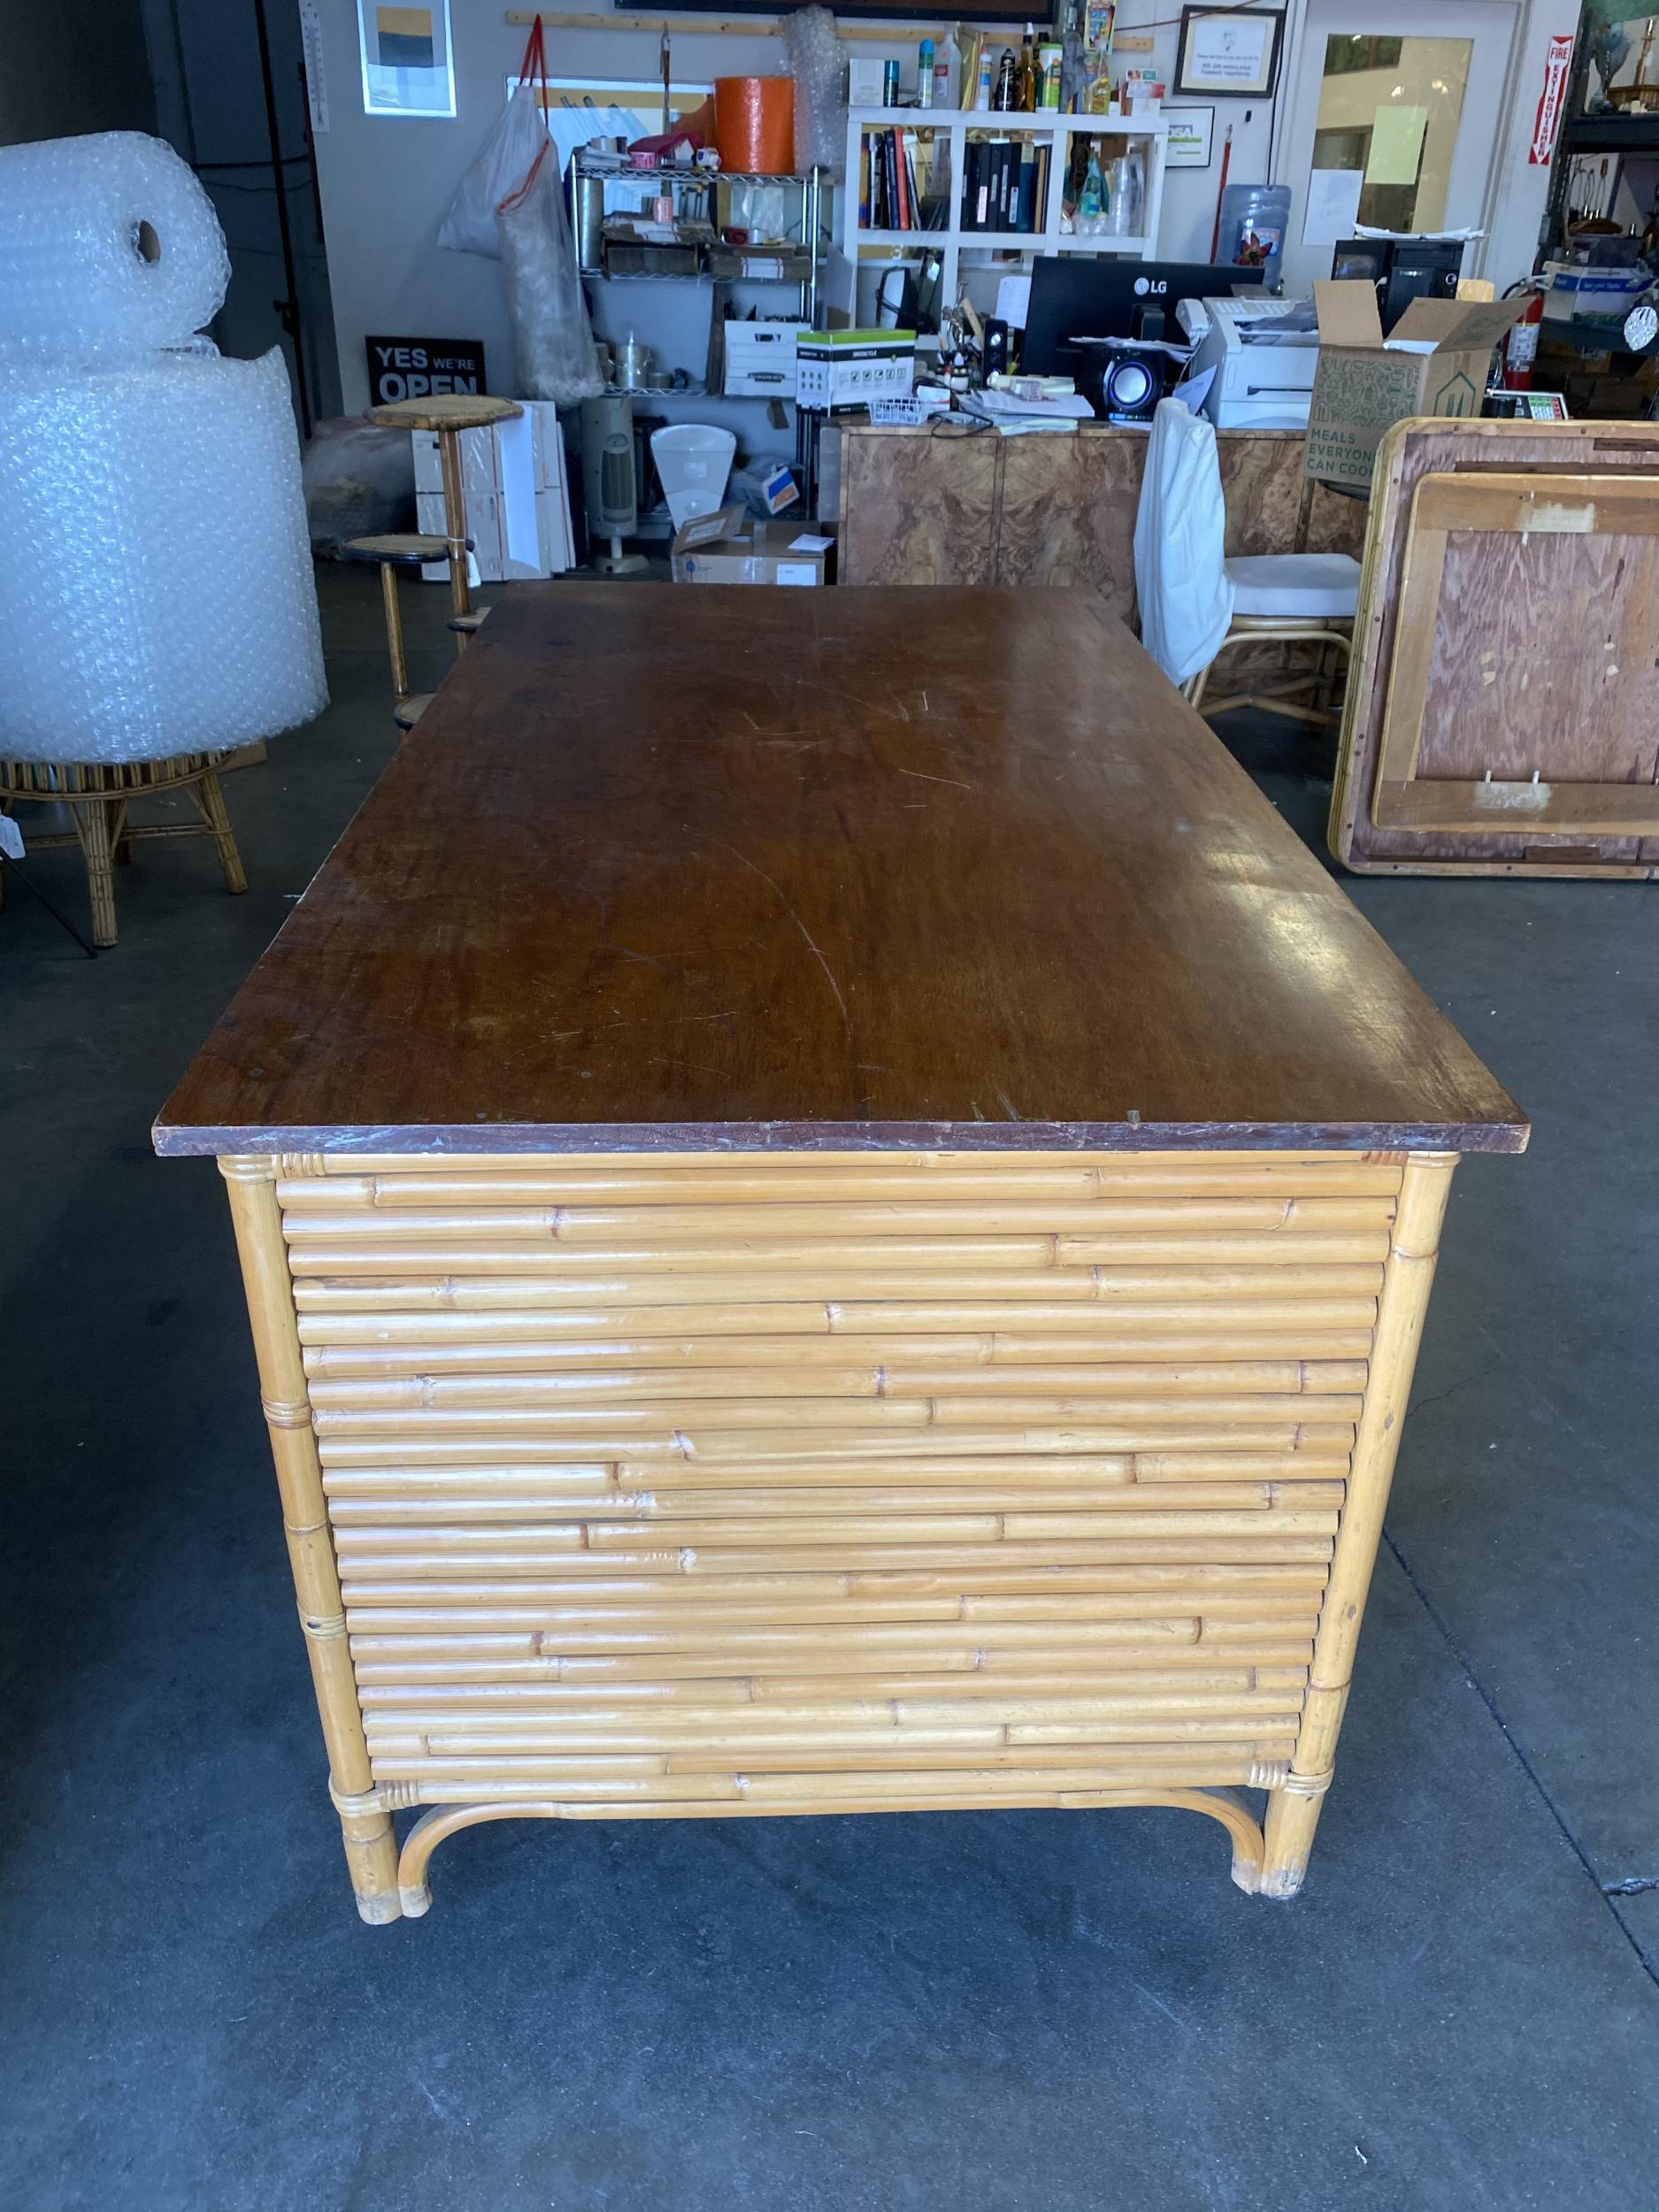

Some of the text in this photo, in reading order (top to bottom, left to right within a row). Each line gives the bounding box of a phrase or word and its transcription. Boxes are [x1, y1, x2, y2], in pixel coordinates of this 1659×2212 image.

[1550, 47, 1569, 59] FIRE
[1538, 64, 1560, 157] EXTINGUISHER
[1150, 280, 1167, 294] LG
[375, 346, 475, 370] YES WE'RE
[379, 373, 478, 404] OPEN
[1310, 428, 1356, 444] MEALS
[1309, 443, 1375, 462] EVERYON
[1307, 458, 1334, 472] CAN
